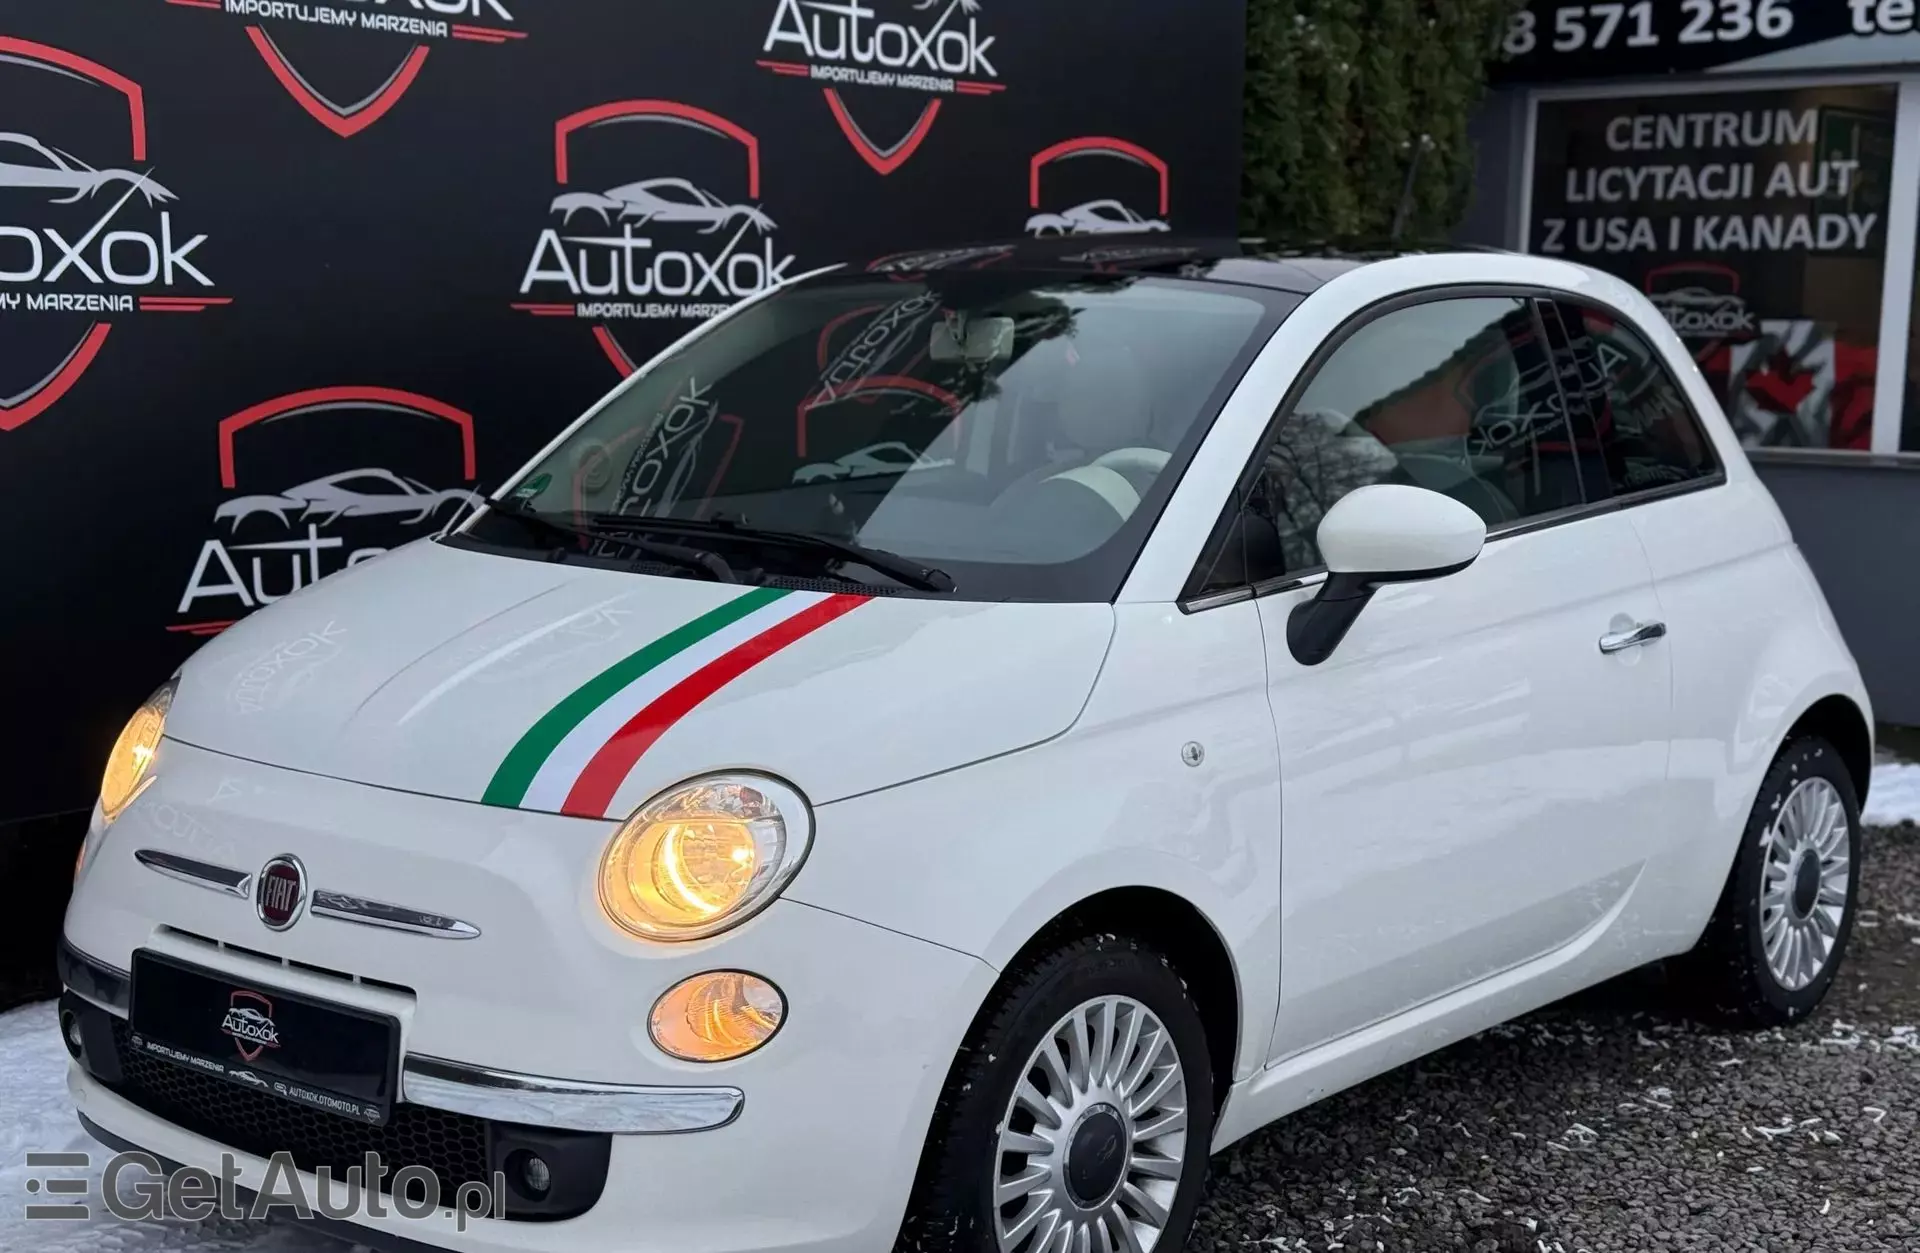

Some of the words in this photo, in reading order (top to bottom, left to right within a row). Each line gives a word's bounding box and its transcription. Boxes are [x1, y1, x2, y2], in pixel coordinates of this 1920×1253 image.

[225, 0, 356, 26] IMPORTUJEMY
[361, 13, 447, 37] MARZENIA
[1552, 1, 1660, 51] 571
[1678, 0, 1794, 44] 236
[763, 0, 997, 77] Autoxok
[810, 64, 895, 87] IMPORTUJEMY
[896, 74, 955, 93] MARZENIA
[1606, 109, 1820, 151] CENTRUM
[1565, 163, 1755, 202] LICYTACJI
[1764, 160, 1860, 197] AUT
[1542, 218, 1565, 253] Z
[1576, 216, 1657, 252] USA
[1669, 216, 1681, 250] I
[1693, 213, 1877, 251] KANADY
[519, 223, 796, 296] Autoxok
[26, 293, 134, 312] MARZENIA
[576, 302, 678, 318] IMPORTUJEMY
[264, 873, 297, 912] FIAT
[221, 1013, 280, 1044] Autoxok
[146, 1041, 190, 1062] IMPORTUJEMY
[190, 1056, 225, 1073] MARZENIA
[288, 1086, 361, 1116] AUTOXOK.OTOMOTO.PL
